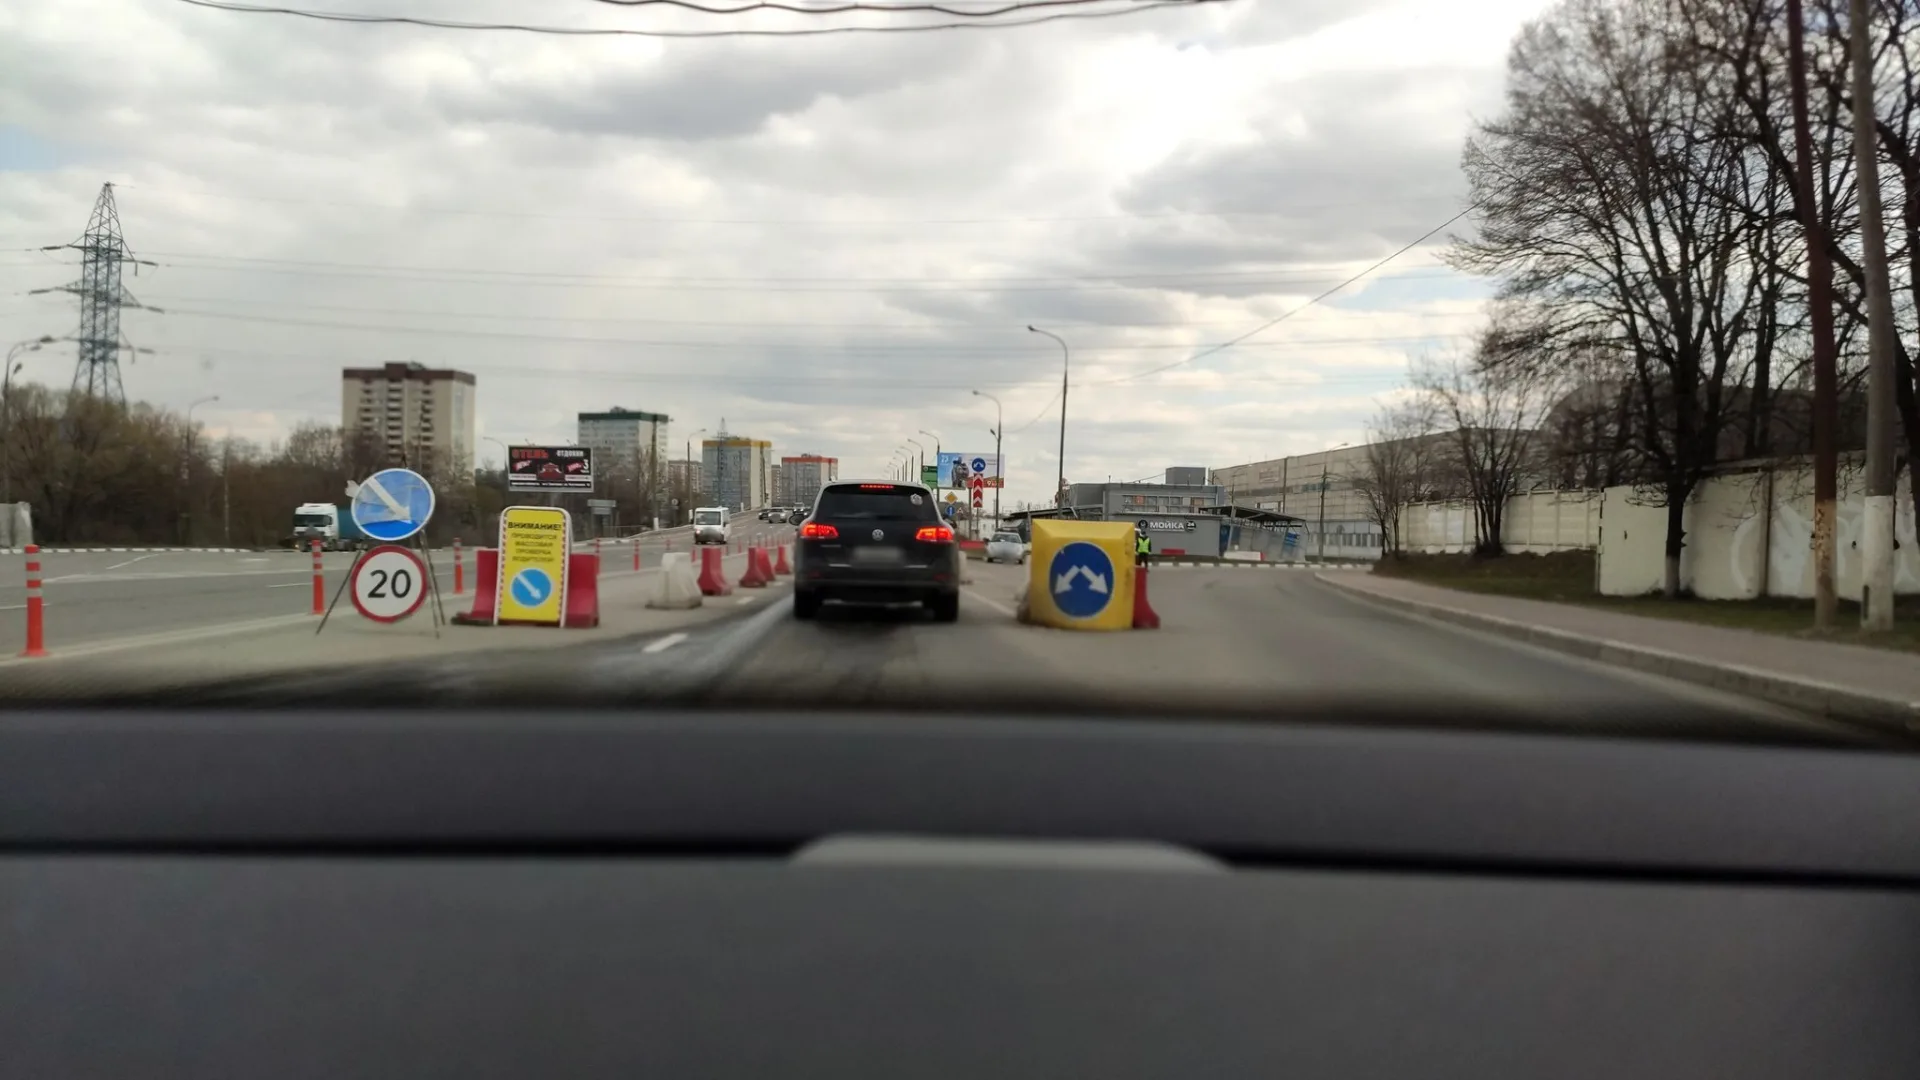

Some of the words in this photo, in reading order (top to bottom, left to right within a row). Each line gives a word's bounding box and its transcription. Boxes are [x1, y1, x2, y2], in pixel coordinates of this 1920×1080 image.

[512, 449, 548, 459] ОТЕЛЬ
[508, 521, 562, 531] ВНИМАНИЕ!
[1149, 520, 1185, 529] МОЙКА
[367, 569, 411, 599] 20
